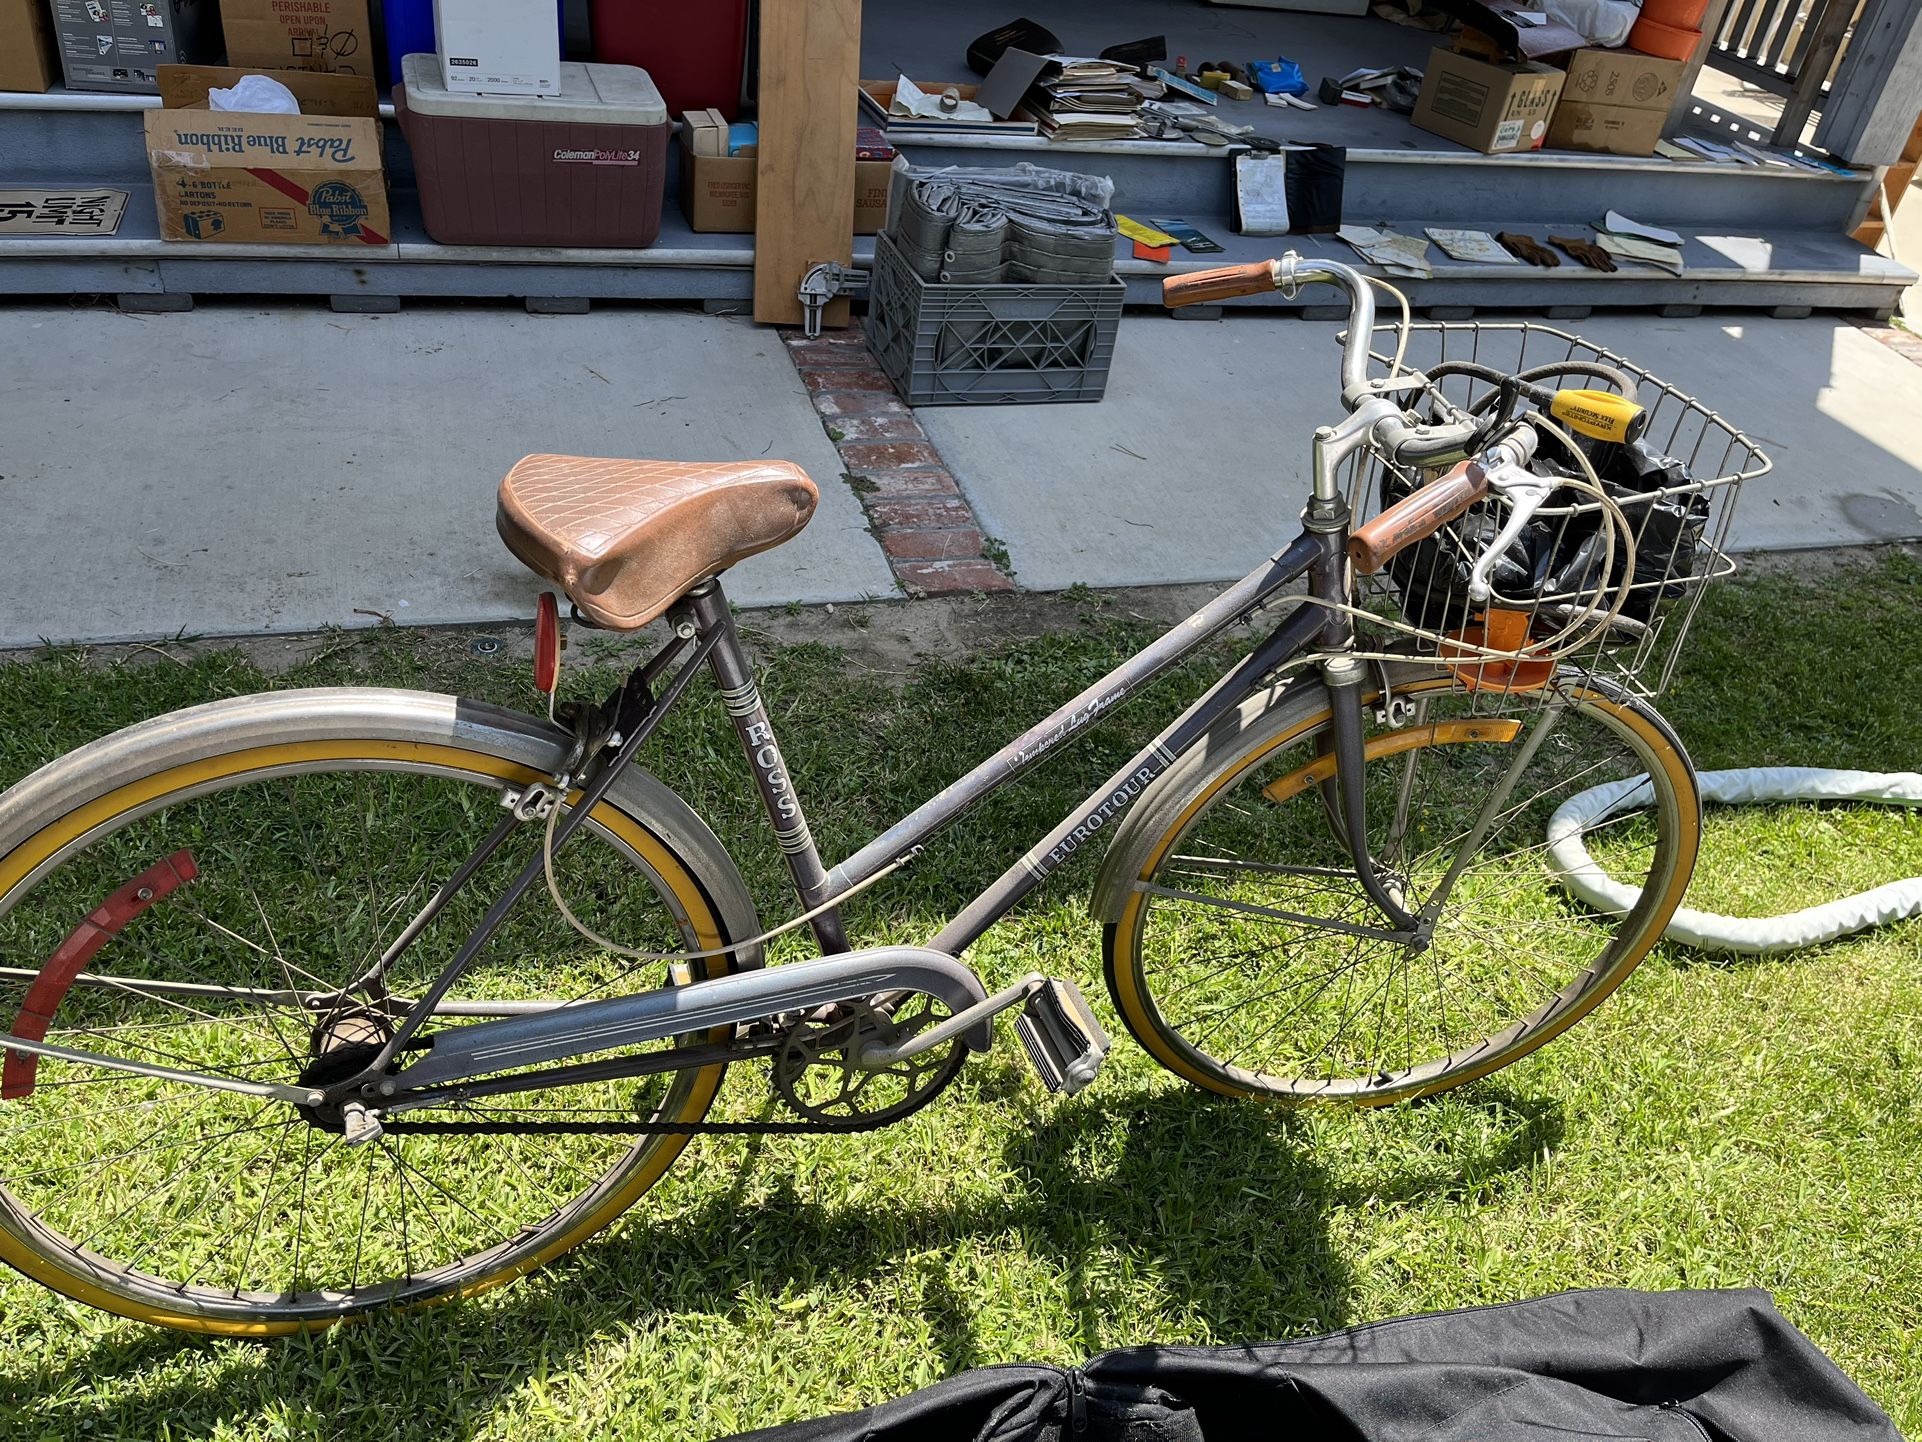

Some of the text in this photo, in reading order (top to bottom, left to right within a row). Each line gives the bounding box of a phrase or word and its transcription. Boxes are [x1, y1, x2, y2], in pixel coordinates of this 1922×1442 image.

[272, 1, 331, 13] PERISHABLE
[279, 14, 326, 25] OPEN UPON
[1517, 89, 1550, 108] GLASS
[177, 132, 356, 164] Pabst Blue Ribbon
[178, 191, 217, 200] CARTONS
[320, 187, 353, 203] Pabst
[309, 204, 368, 216] Blue Ribbon
[1088, 687, 1127, 716] Frame
[745, 721, 797, 820] ROSS
[1049, 766, 1156, 864] EUROTOUR
